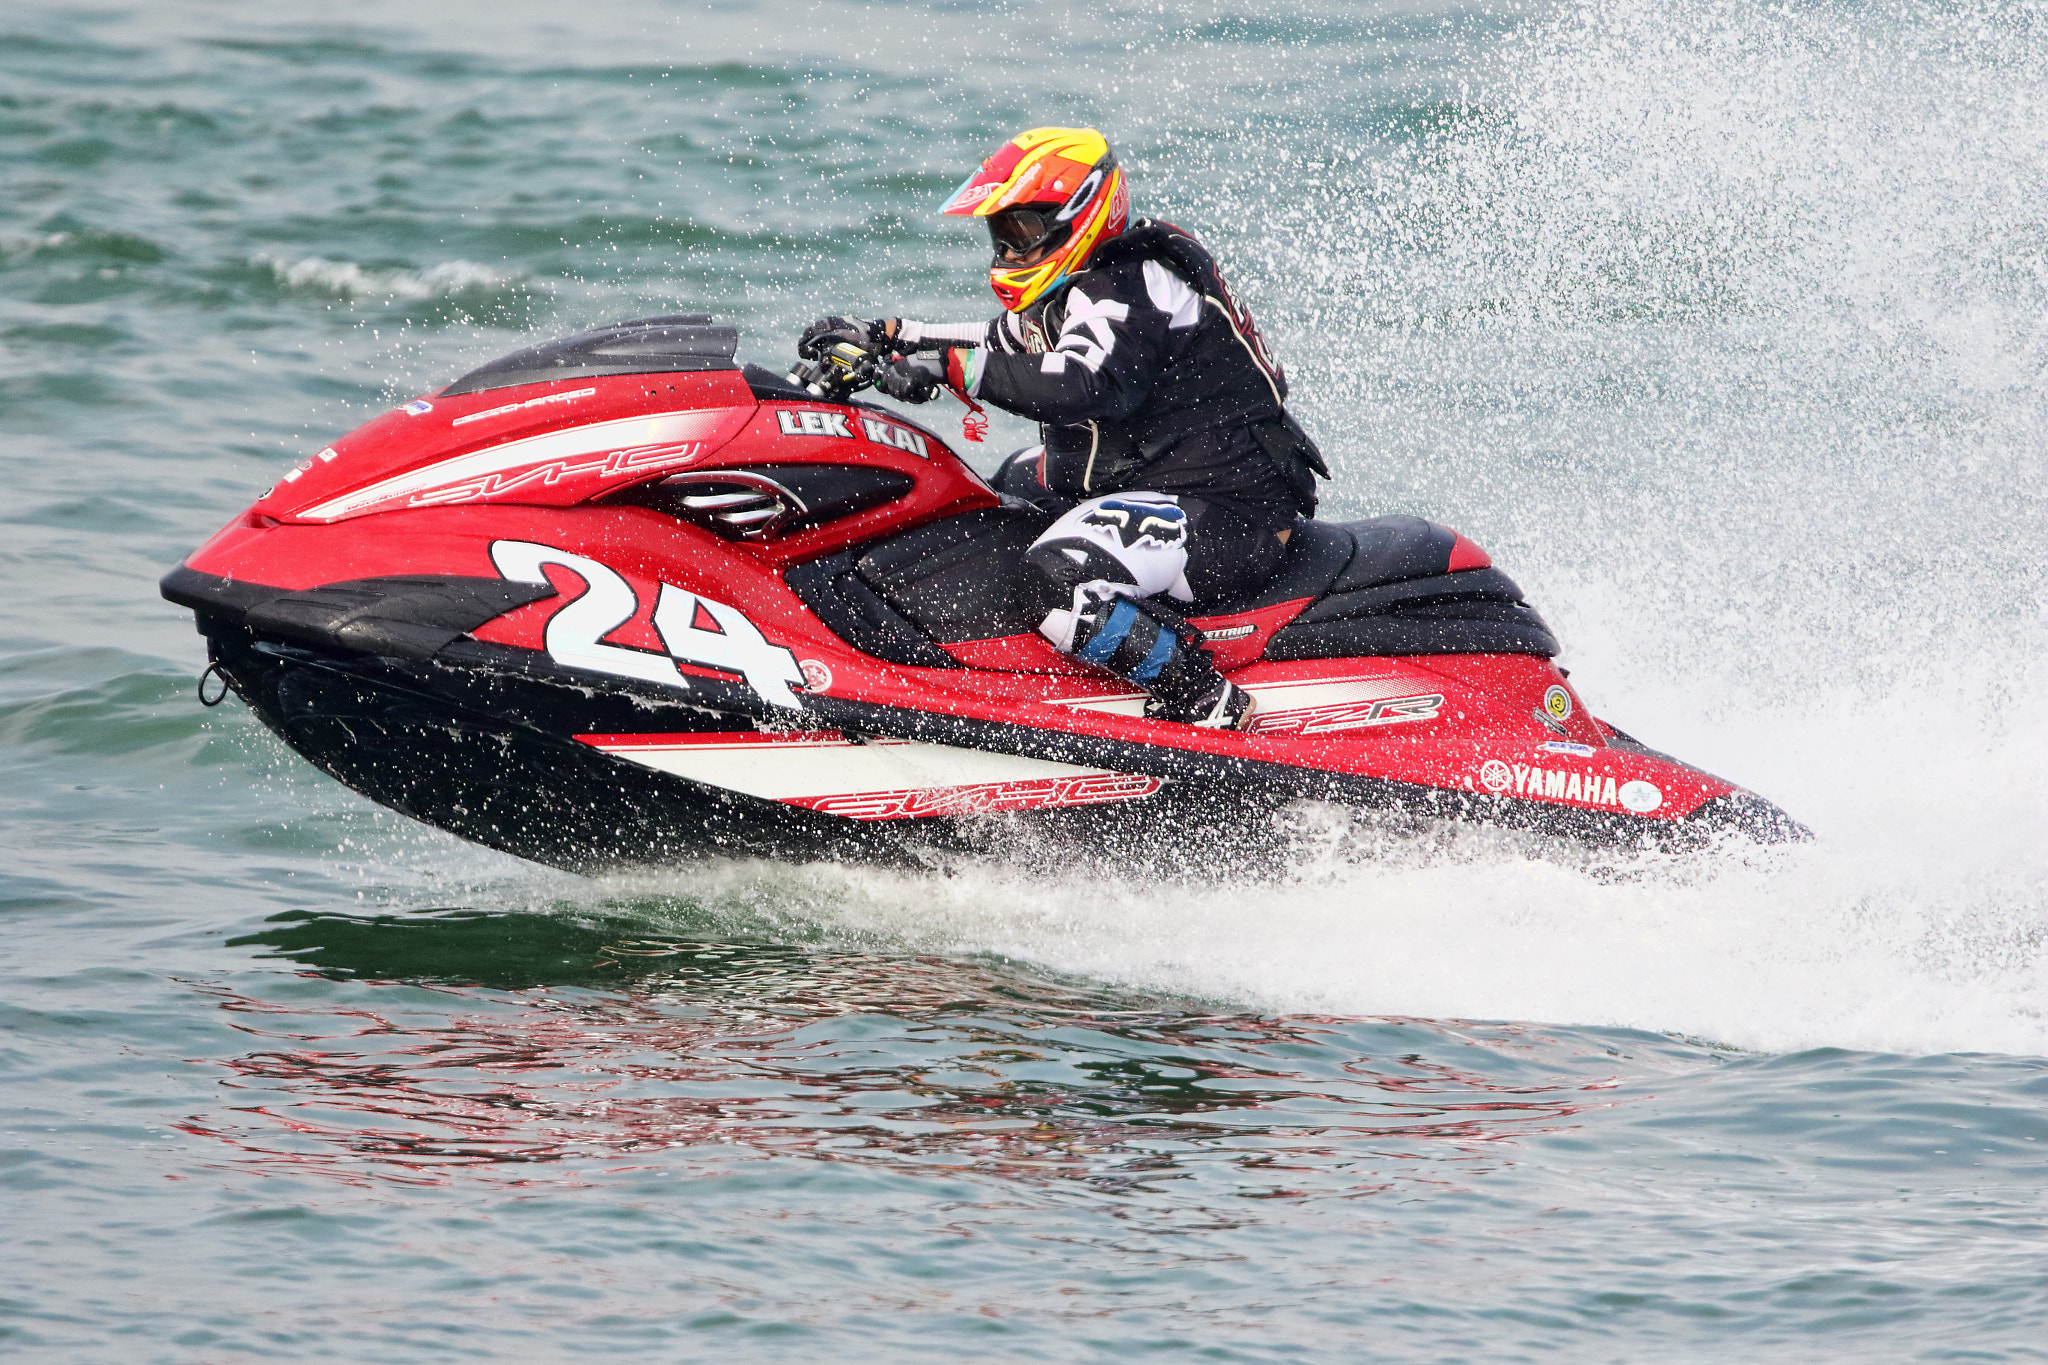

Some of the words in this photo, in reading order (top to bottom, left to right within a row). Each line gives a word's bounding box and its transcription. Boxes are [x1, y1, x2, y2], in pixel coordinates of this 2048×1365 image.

[776, 410, 856, 439] LEK
[862, 418, 931, 461] KAI
[488, 539, 812, 711] 24
[1511, 763, 1617, 806] YAMAHA
